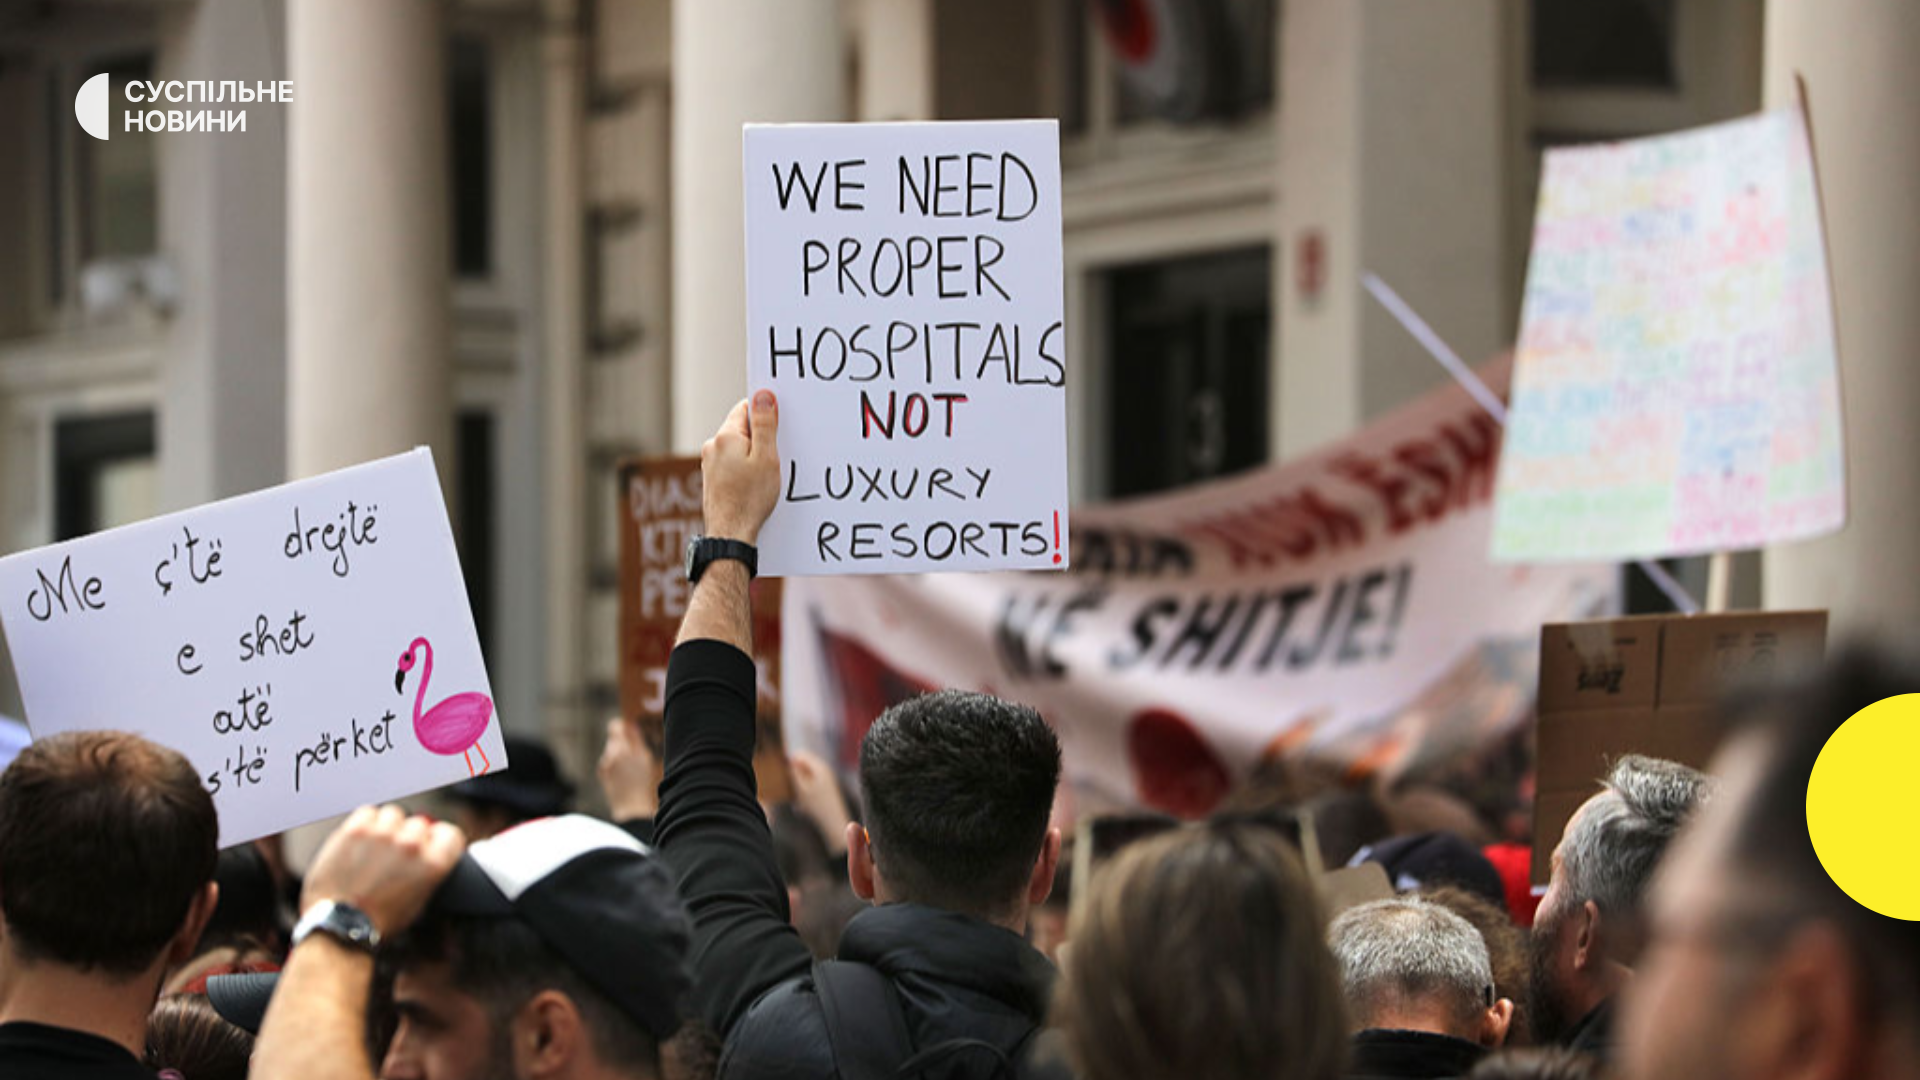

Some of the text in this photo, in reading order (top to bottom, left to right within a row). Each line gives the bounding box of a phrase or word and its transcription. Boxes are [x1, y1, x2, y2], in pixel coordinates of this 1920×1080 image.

[771, 151, 1038, 222] WE NEED
[803, 234, 1012, 302] PROPER
[769, 320, 1066, 388] HOSPITALS
[860, 389, 969, 440] NOT
[785, 459, 991, 503] LUXURY
[27, 554, 106, 622] Me
[284, 501, 378, 578] drejtë
[816, 509, 1063, 565] RESORTS!
[177, 609, 315, 676] e shet
[212, 683, 273, 735] atë
[294, 710, 396, 793] përket
